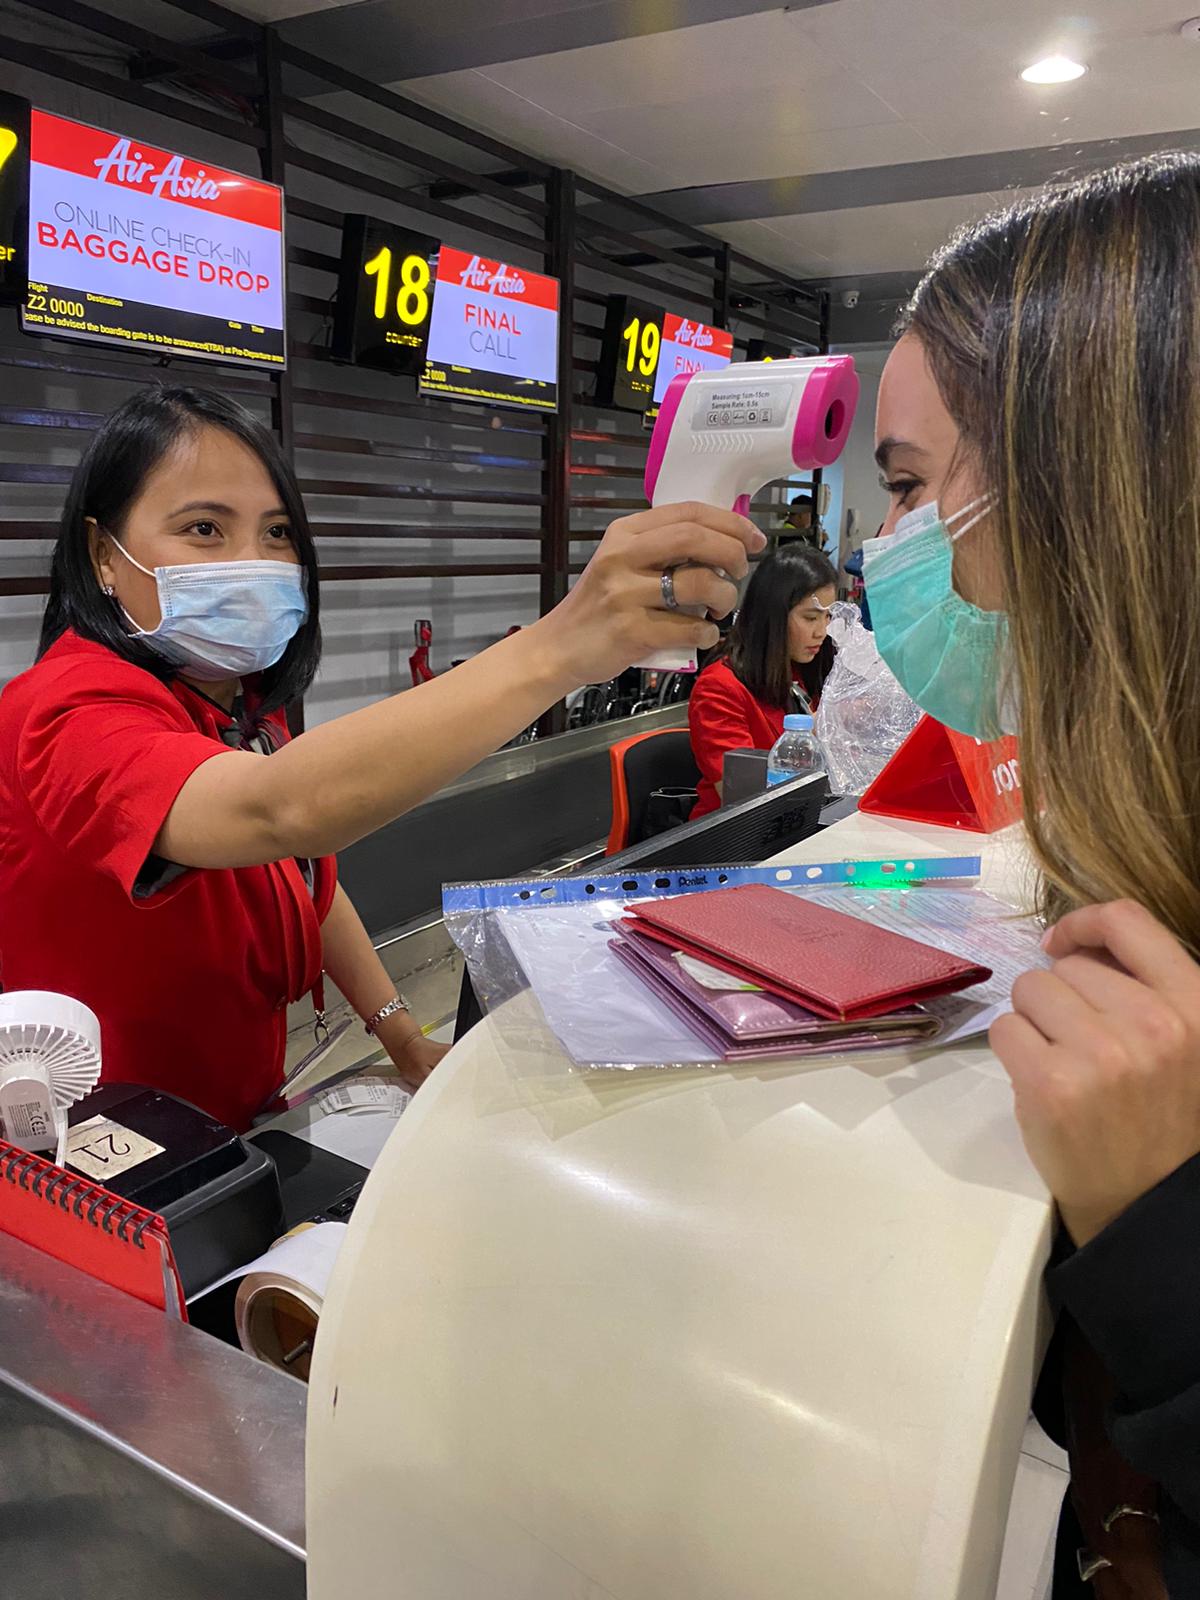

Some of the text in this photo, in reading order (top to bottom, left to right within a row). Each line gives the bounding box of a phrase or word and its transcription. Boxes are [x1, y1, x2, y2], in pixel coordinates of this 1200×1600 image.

[37, 221, 270, 294] BAGGAGE DROP
[54, 201, 251, 268] ONLINE CHECK-IN
[27, 281, 48, 293] Flight
[27, 293, 85, 318] Z2 0000
[364, 246, 431, 326] 18
[463, 302, 523, 337] FINAL
[468, 329, 518, 361] CALL
[623, 318, 660, 377] 19
